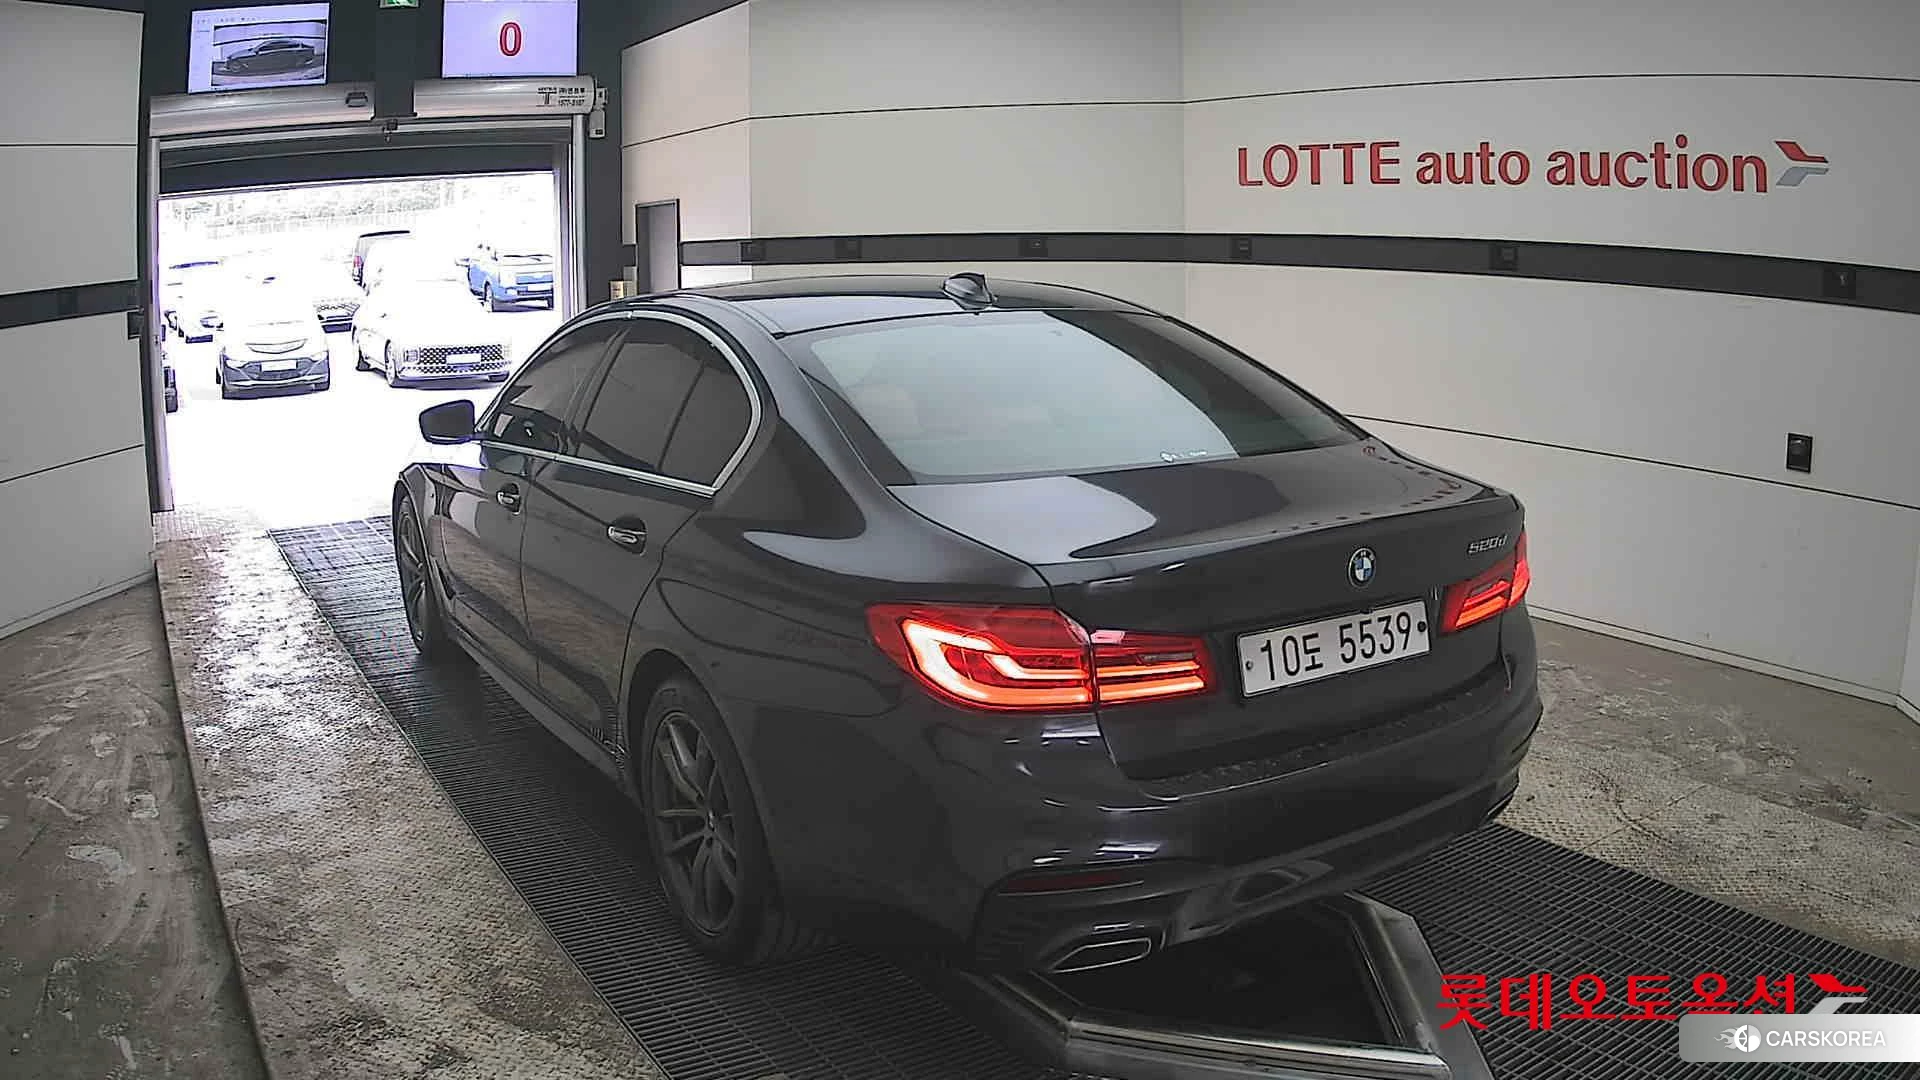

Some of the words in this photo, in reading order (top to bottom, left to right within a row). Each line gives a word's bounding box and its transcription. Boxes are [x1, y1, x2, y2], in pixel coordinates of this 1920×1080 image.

[499, 22, 522, 57] 0
[1238, 141, 1400, 187] LOTTE
[1416, 141, 1530, 186] auto
[1546, 135, 1768, 193] auction
[1467, 534, 1508, 554] 520d
[1260, 632, 1324, 682] 10도
[1339, 611, 1412, 664] 5539
